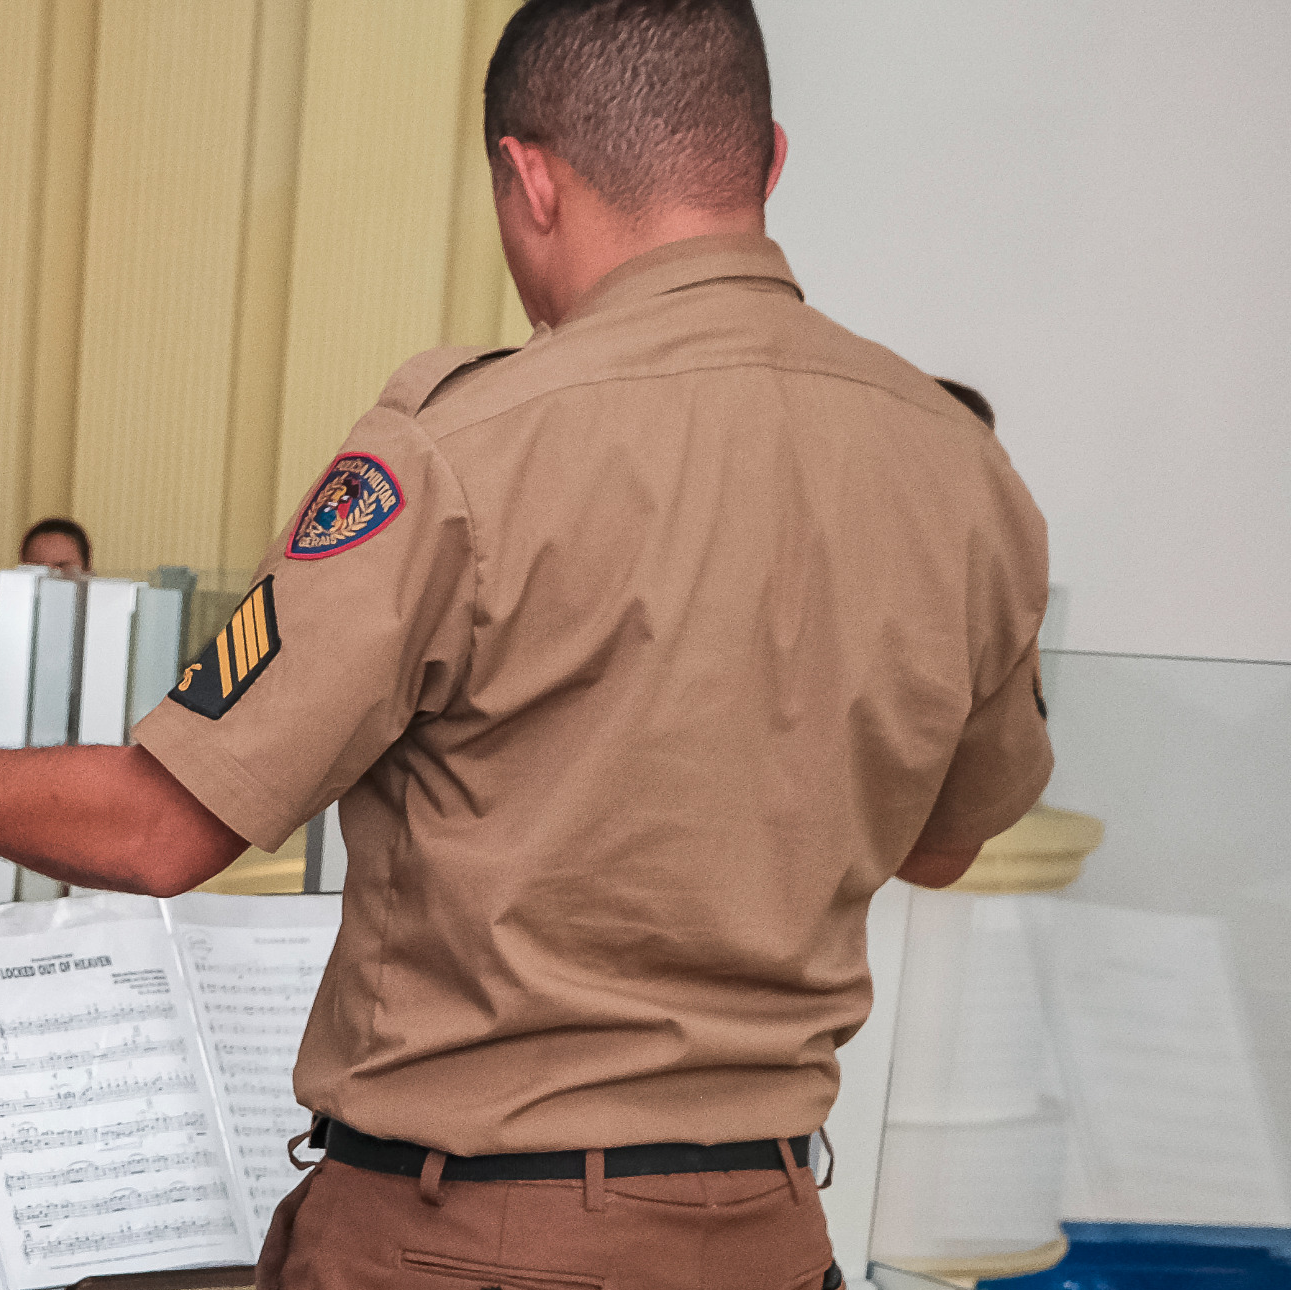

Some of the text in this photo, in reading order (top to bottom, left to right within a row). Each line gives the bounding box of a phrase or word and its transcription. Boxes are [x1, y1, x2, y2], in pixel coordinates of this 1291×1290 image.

[0, 966, 35, 979] LOCKED
[39, 963, 57, 976] OUT
[59, 961, 71, 973] OF
[75, 956, 112, 970] HEAVEN
